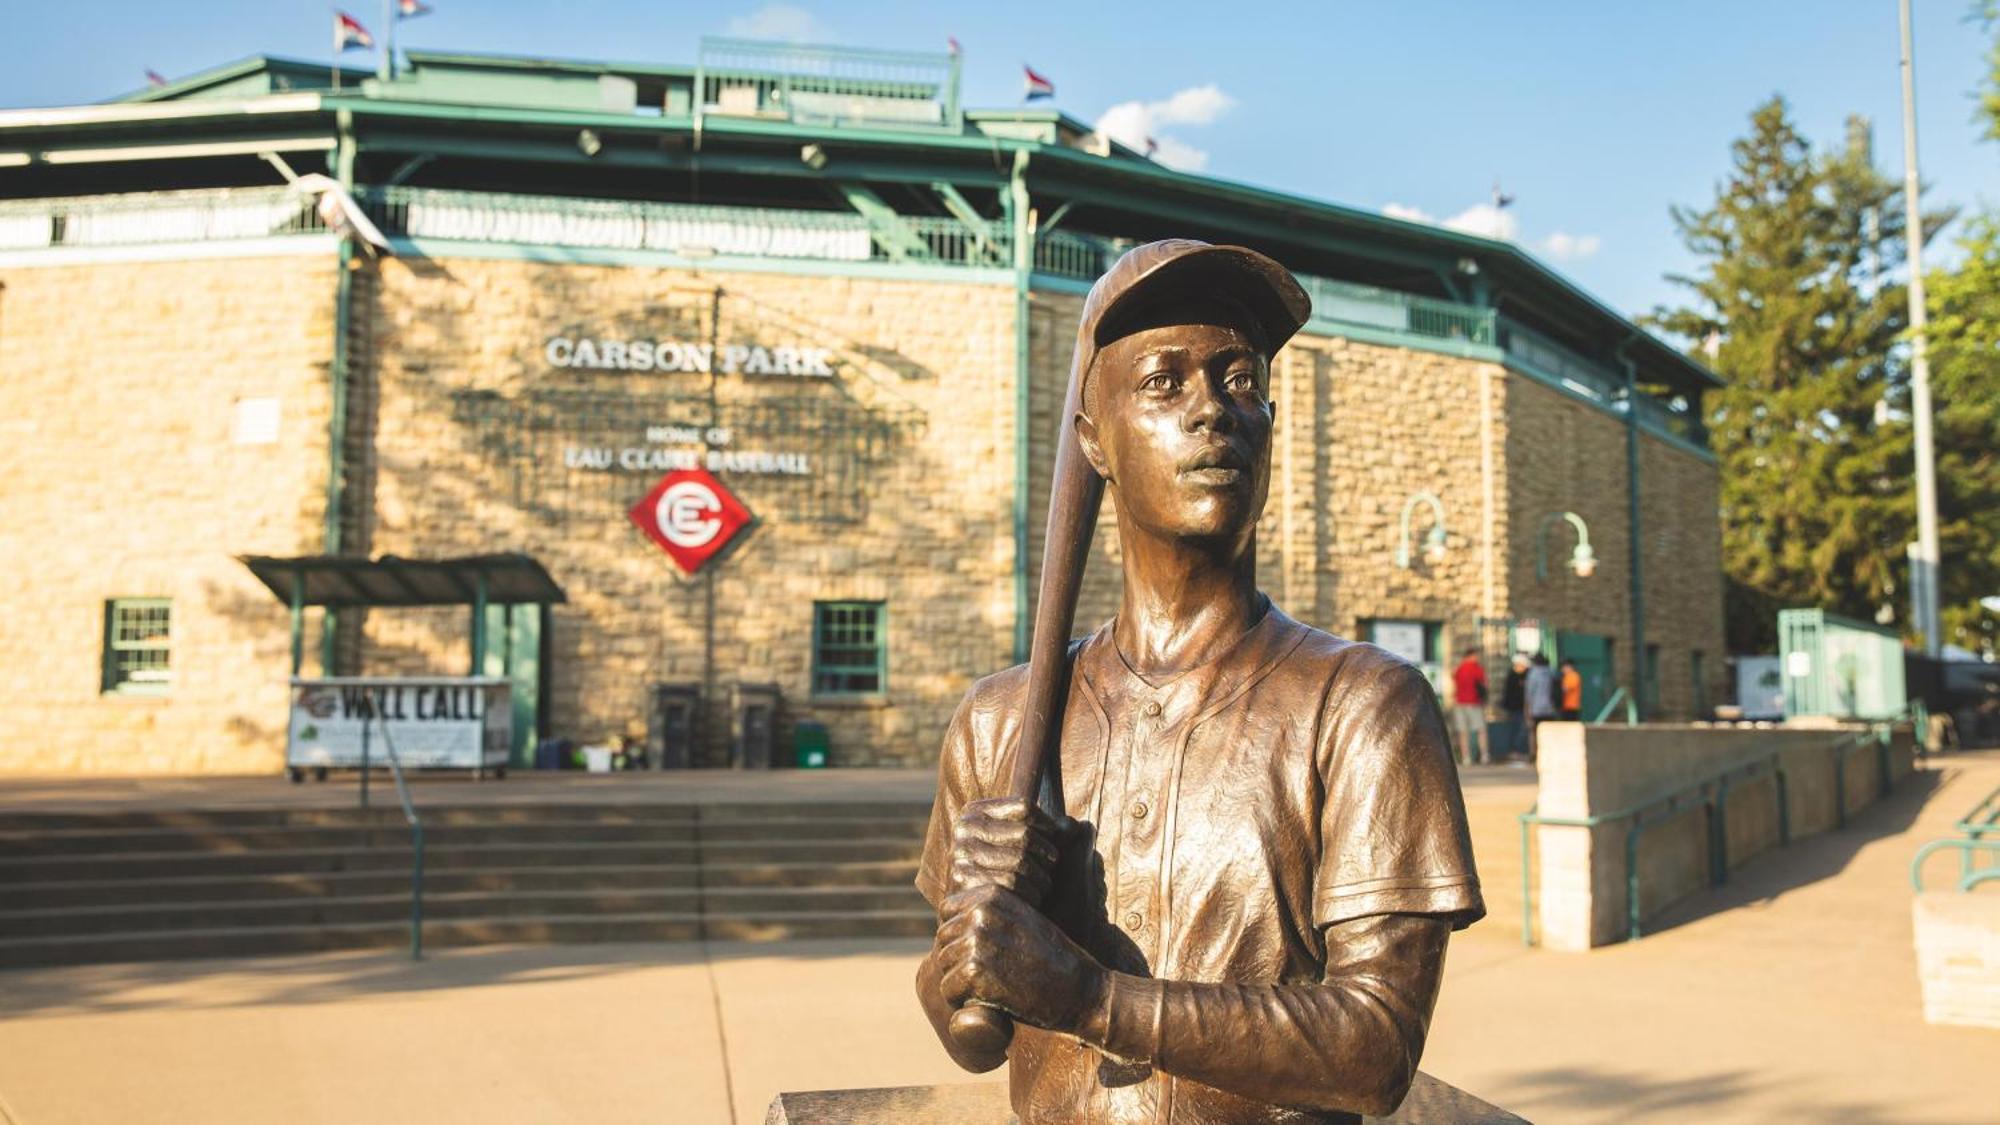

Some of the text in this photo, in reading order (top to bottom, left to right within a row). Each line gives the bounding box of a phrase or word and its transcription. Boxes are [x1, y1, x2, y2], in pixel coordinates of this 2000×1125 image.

[546, 337, 832, 376] CARSON PARK
[646, 426, 699, 442] HOME
[707, 450, 811, 475] BASEBALL
[416, 685, 483, 719] CALL
